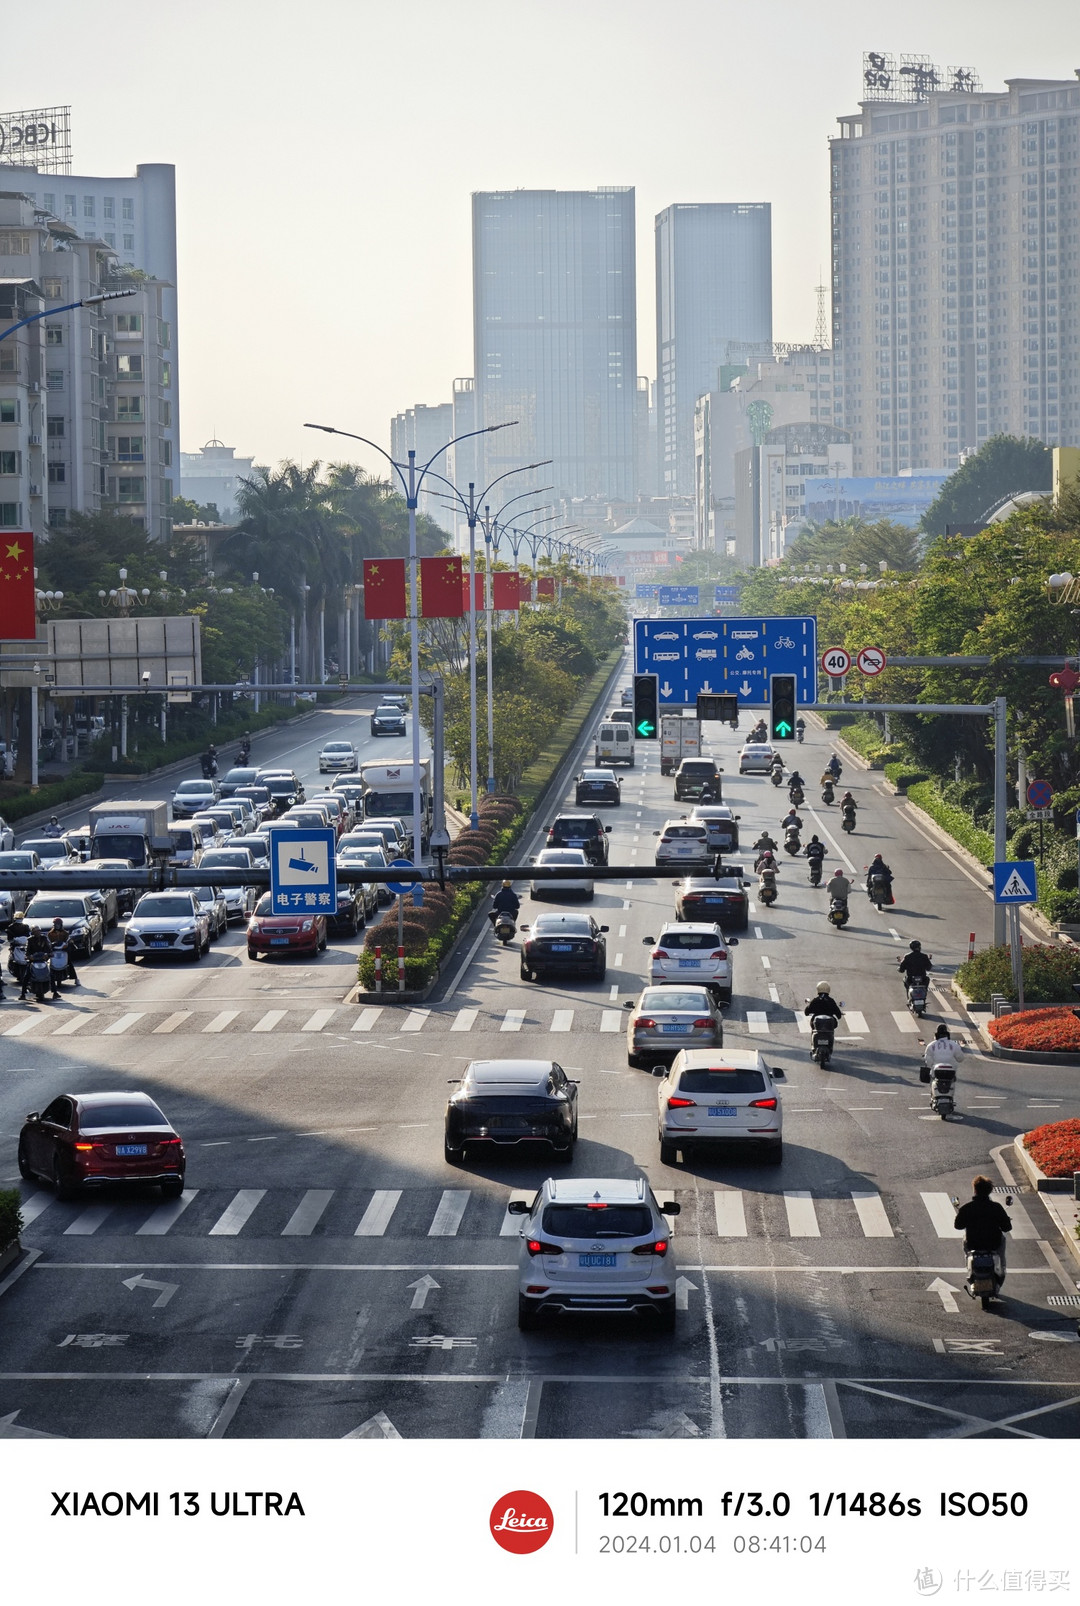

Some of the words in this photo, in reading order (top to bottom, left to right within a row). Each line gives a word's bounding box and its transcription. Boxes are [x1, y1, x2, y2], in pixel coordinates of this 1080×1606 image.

[828, 655, 845, 669] 40
[277, 892, 331, 906] 电子警察
